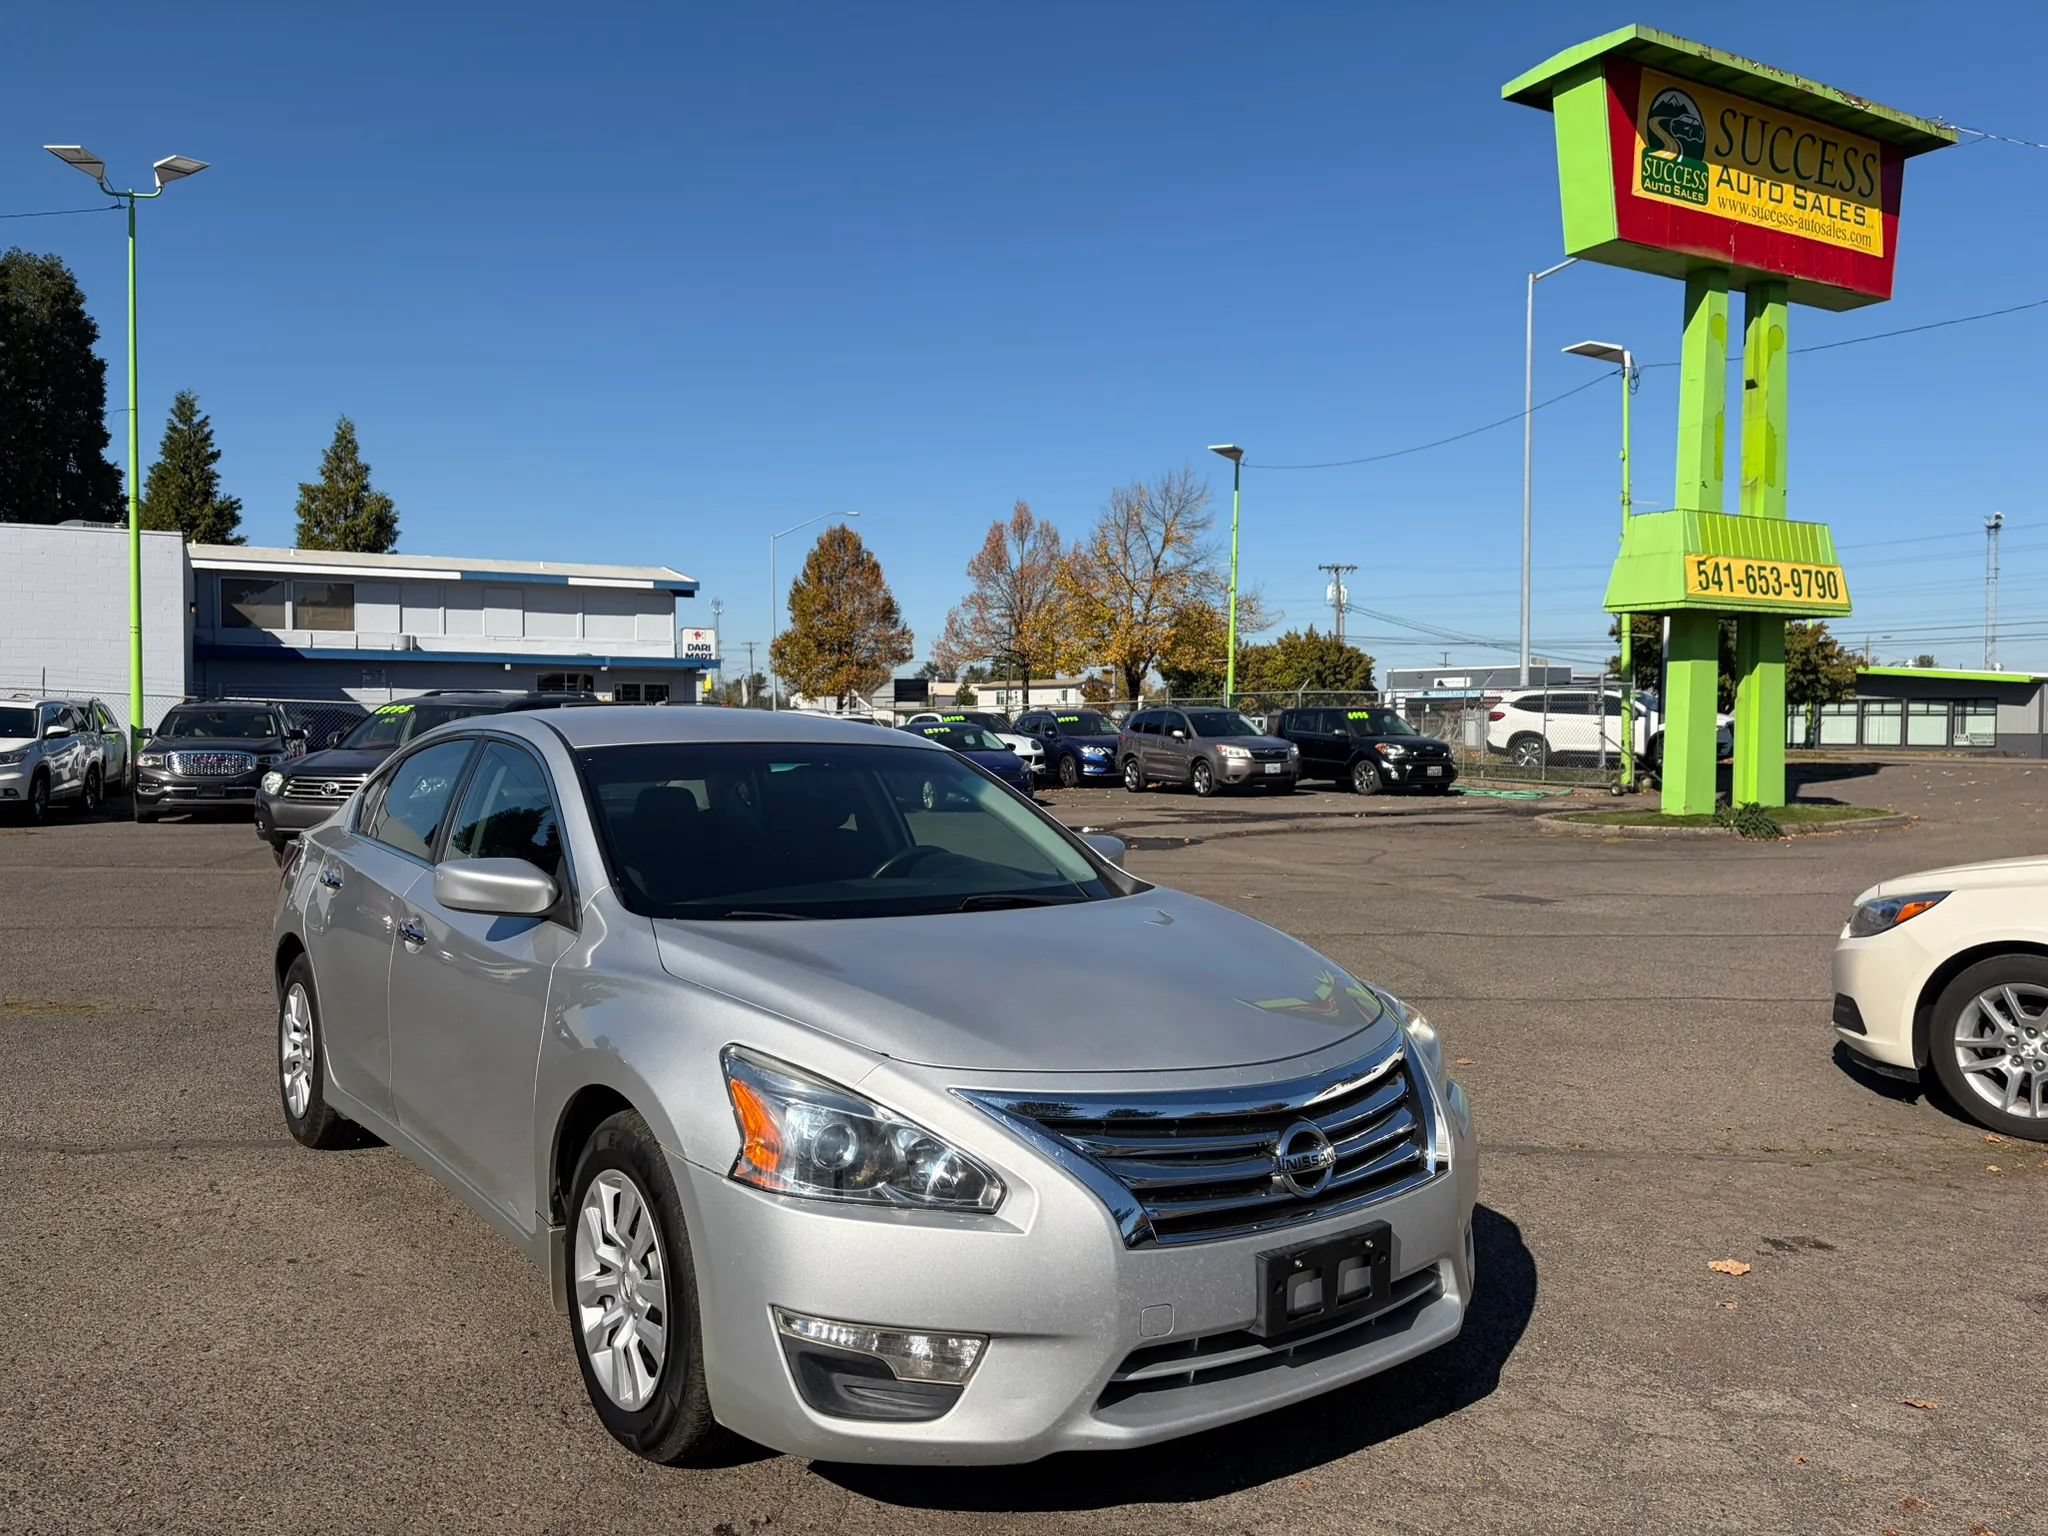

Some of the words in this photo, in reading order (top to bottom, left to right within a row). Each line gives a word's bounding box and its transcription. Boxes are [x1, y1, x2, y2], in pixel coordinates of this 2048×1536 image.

[1714, 107, 1877, 198] SUCCESS
[1642, 157, 1708, 190] SUCCESS
[1643, 178, 1672, 194] AUTO
[1673, 185, 1704, 202] SALES
[1716, 164, 1784, 204] AUTO
[1792, 183, 1867, 226] SALES
[1717, 195, 1872, 247] www.success-autosales.com
[1696, 560, 1839, 600] 541-653-9790
[685, 652, 713, 660] MART
[687, 643, 711, 652] DARI
[1285, 1148, 1335, 1170] NISSAN
